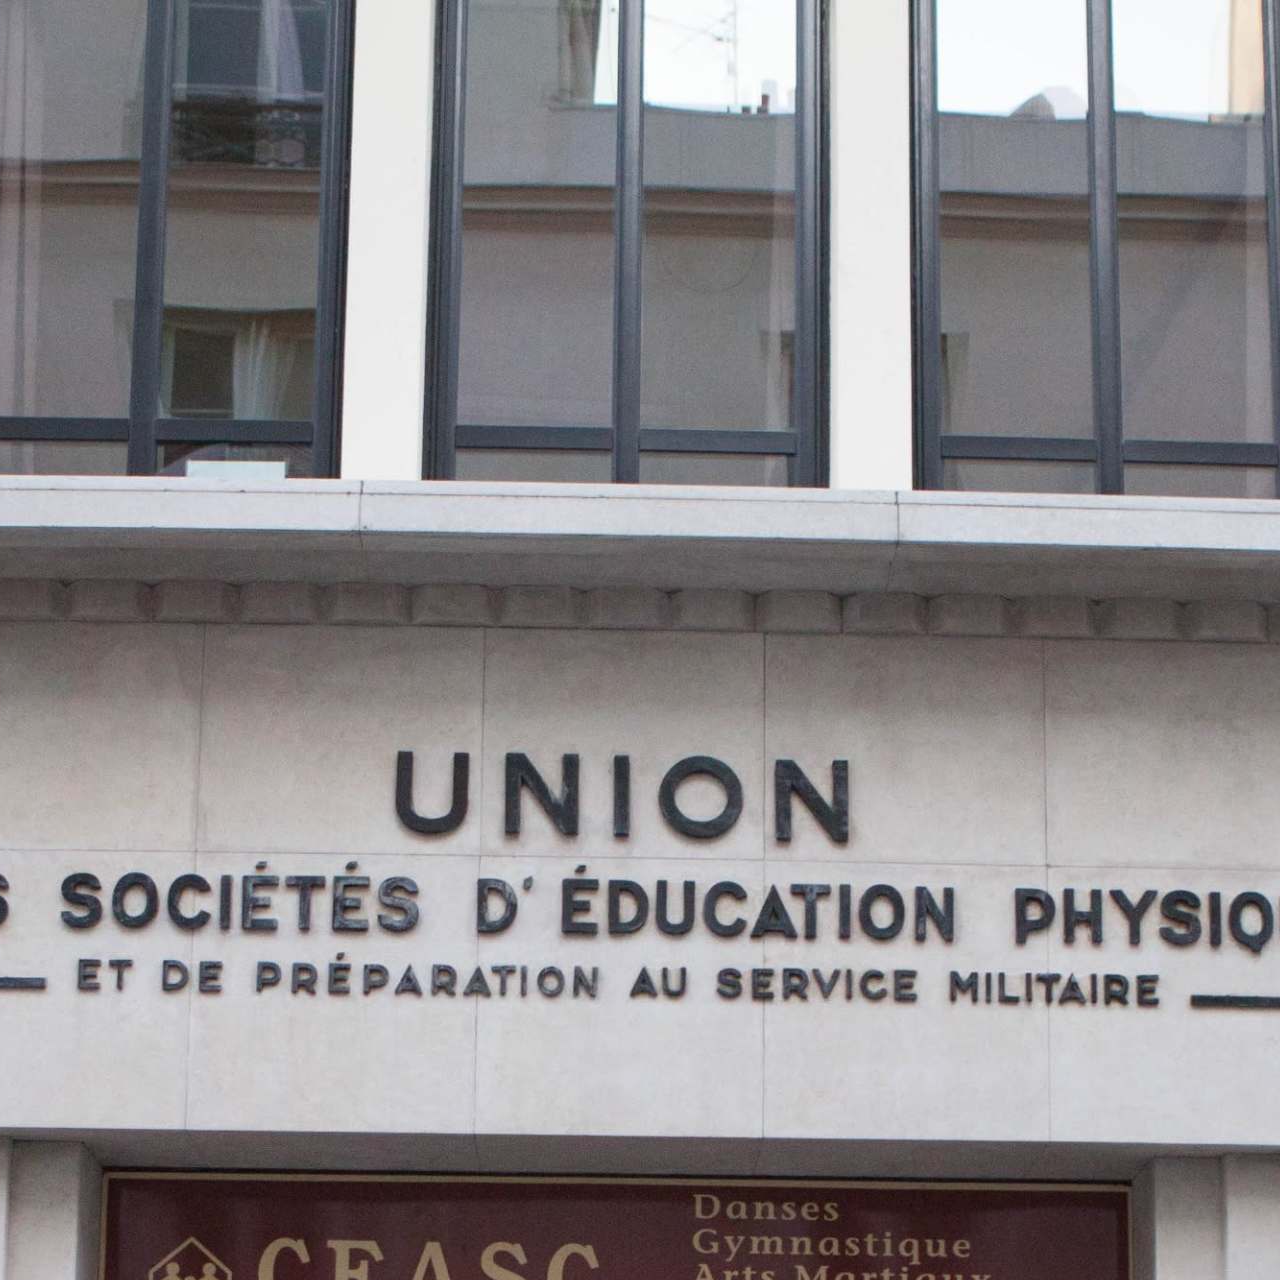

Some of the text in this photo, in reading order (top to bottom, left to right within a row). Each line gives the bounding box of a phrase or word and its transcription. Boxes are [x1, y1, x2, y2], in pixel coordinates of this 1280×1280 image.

[393, 750, 850, 844] UNION
[60, 861, 422, 936] SOCIÉTÉS
[77, 951, 1160, 1007] ET DE PRÉPARATION AU SERVICE MILITAIRE
[693, 1193, 840, 1222] Danses
[691, 1228, 972, 1263] Gymnastique
